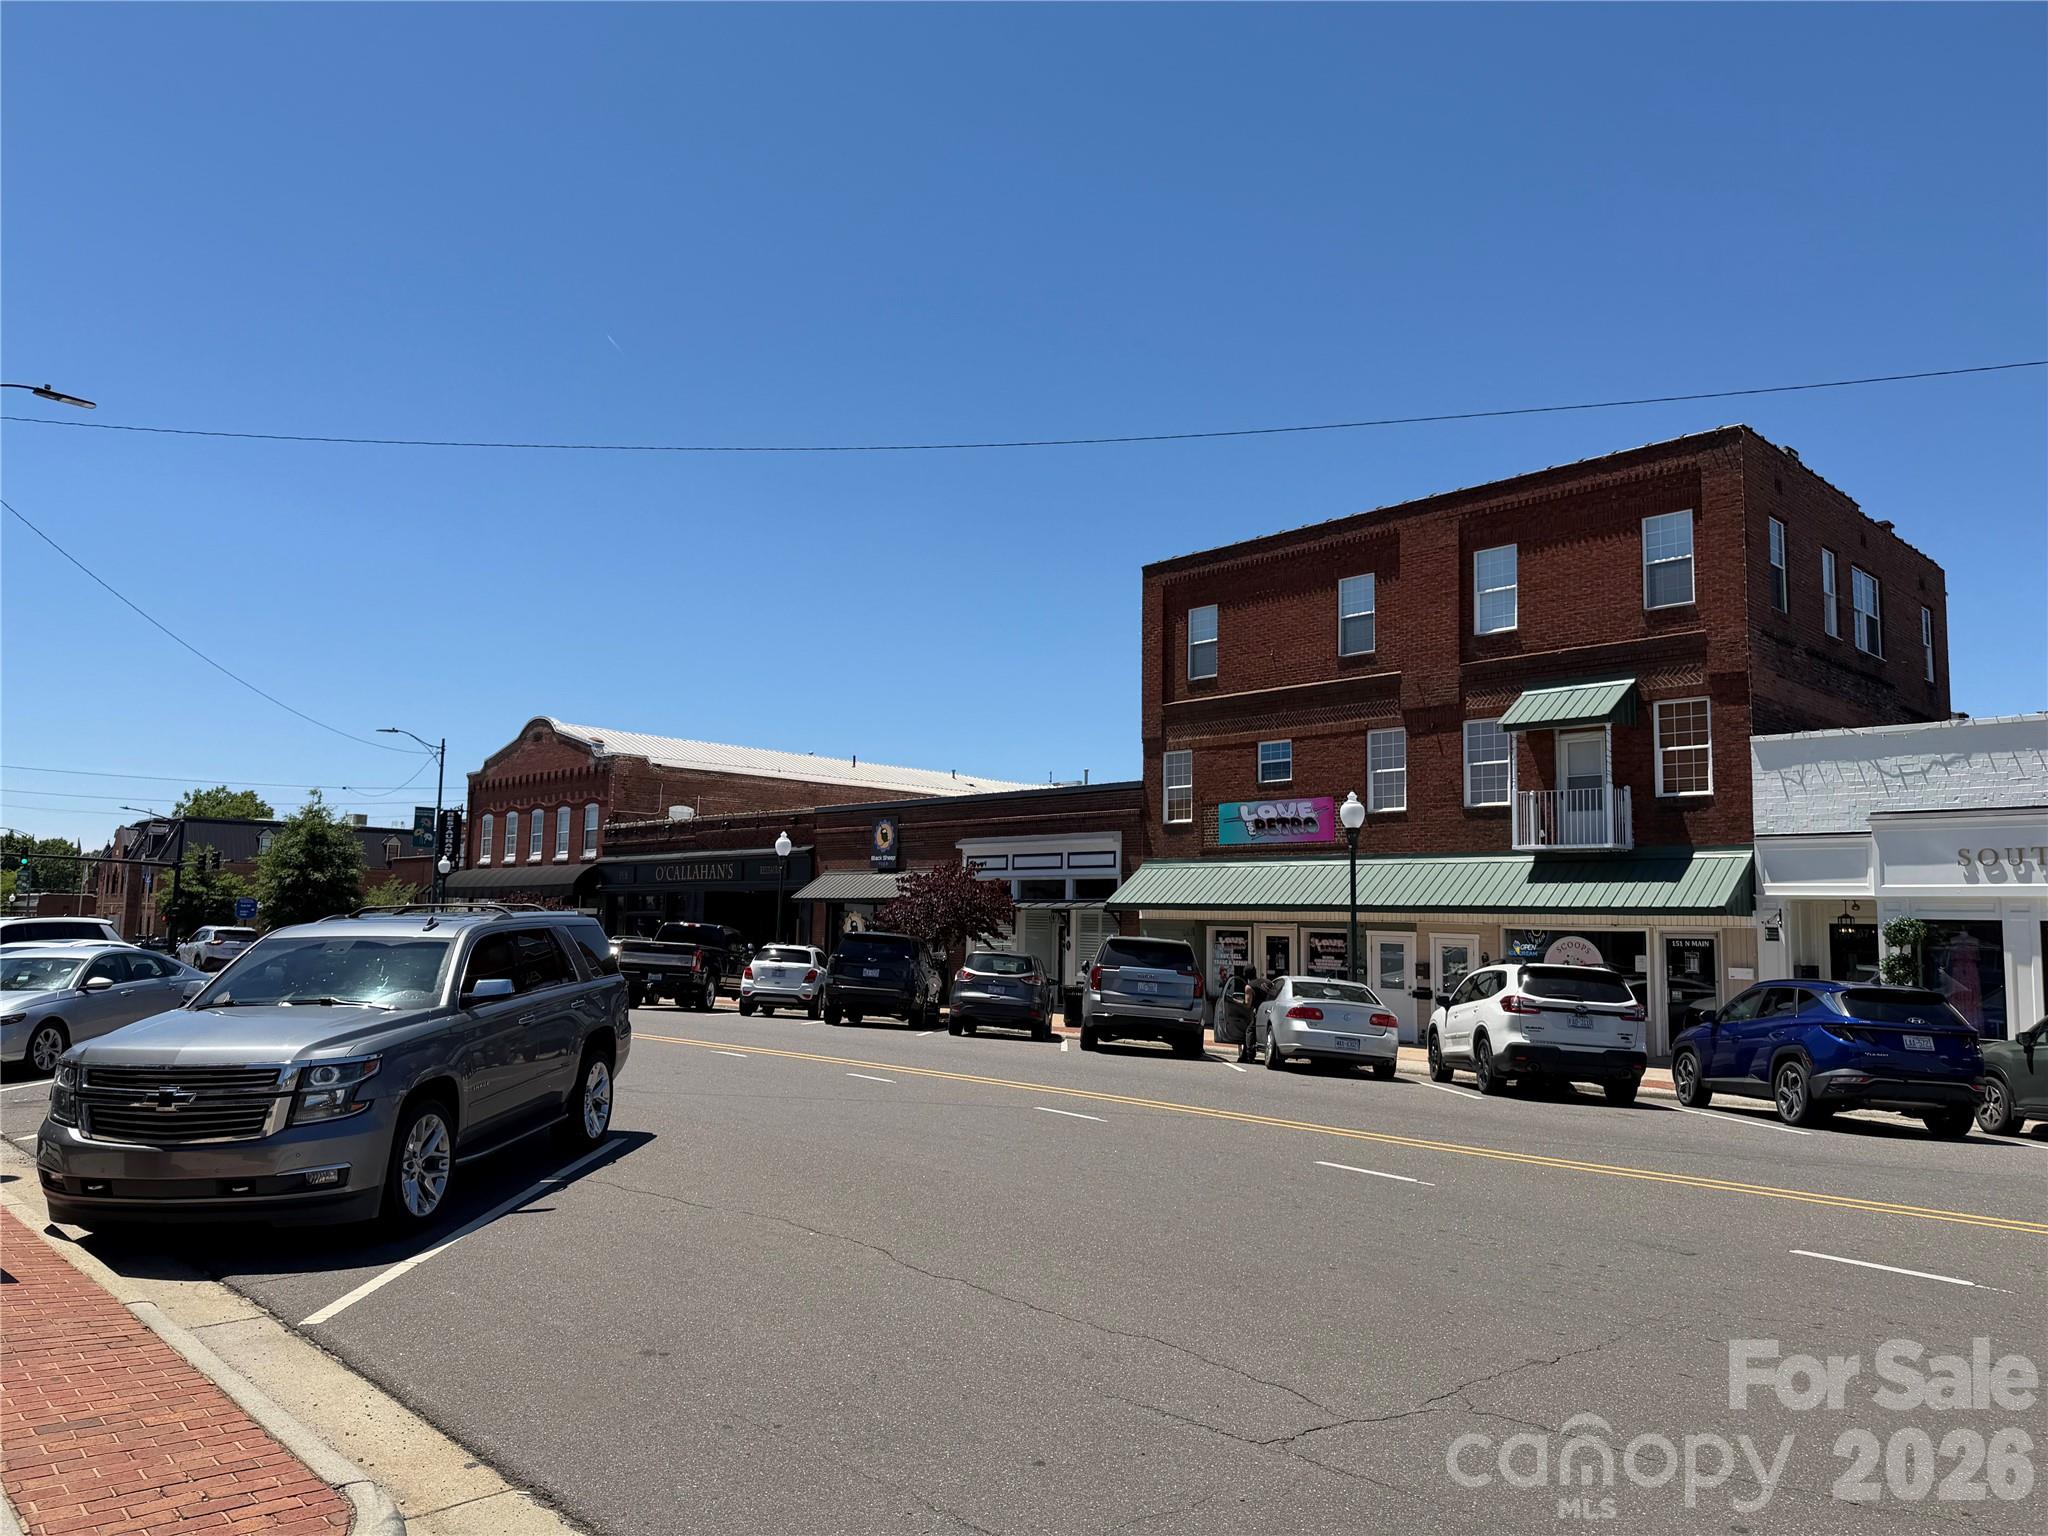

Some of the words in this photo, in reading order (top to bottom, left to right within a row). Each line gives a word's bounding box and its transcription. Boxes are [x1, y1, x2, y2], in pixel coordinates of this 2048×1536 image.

[1240, 802, 1316, 821] LOVE
[444, 812, 455, 857] RESTAURANT
[1254, 817, 1319, 836] RETRO
[655, 863, 734, 881] O'CALLAHAN'S
[1520, 943, 1537, 951] OPEN
[1555, 940, 1592, 955] SCOOPS
